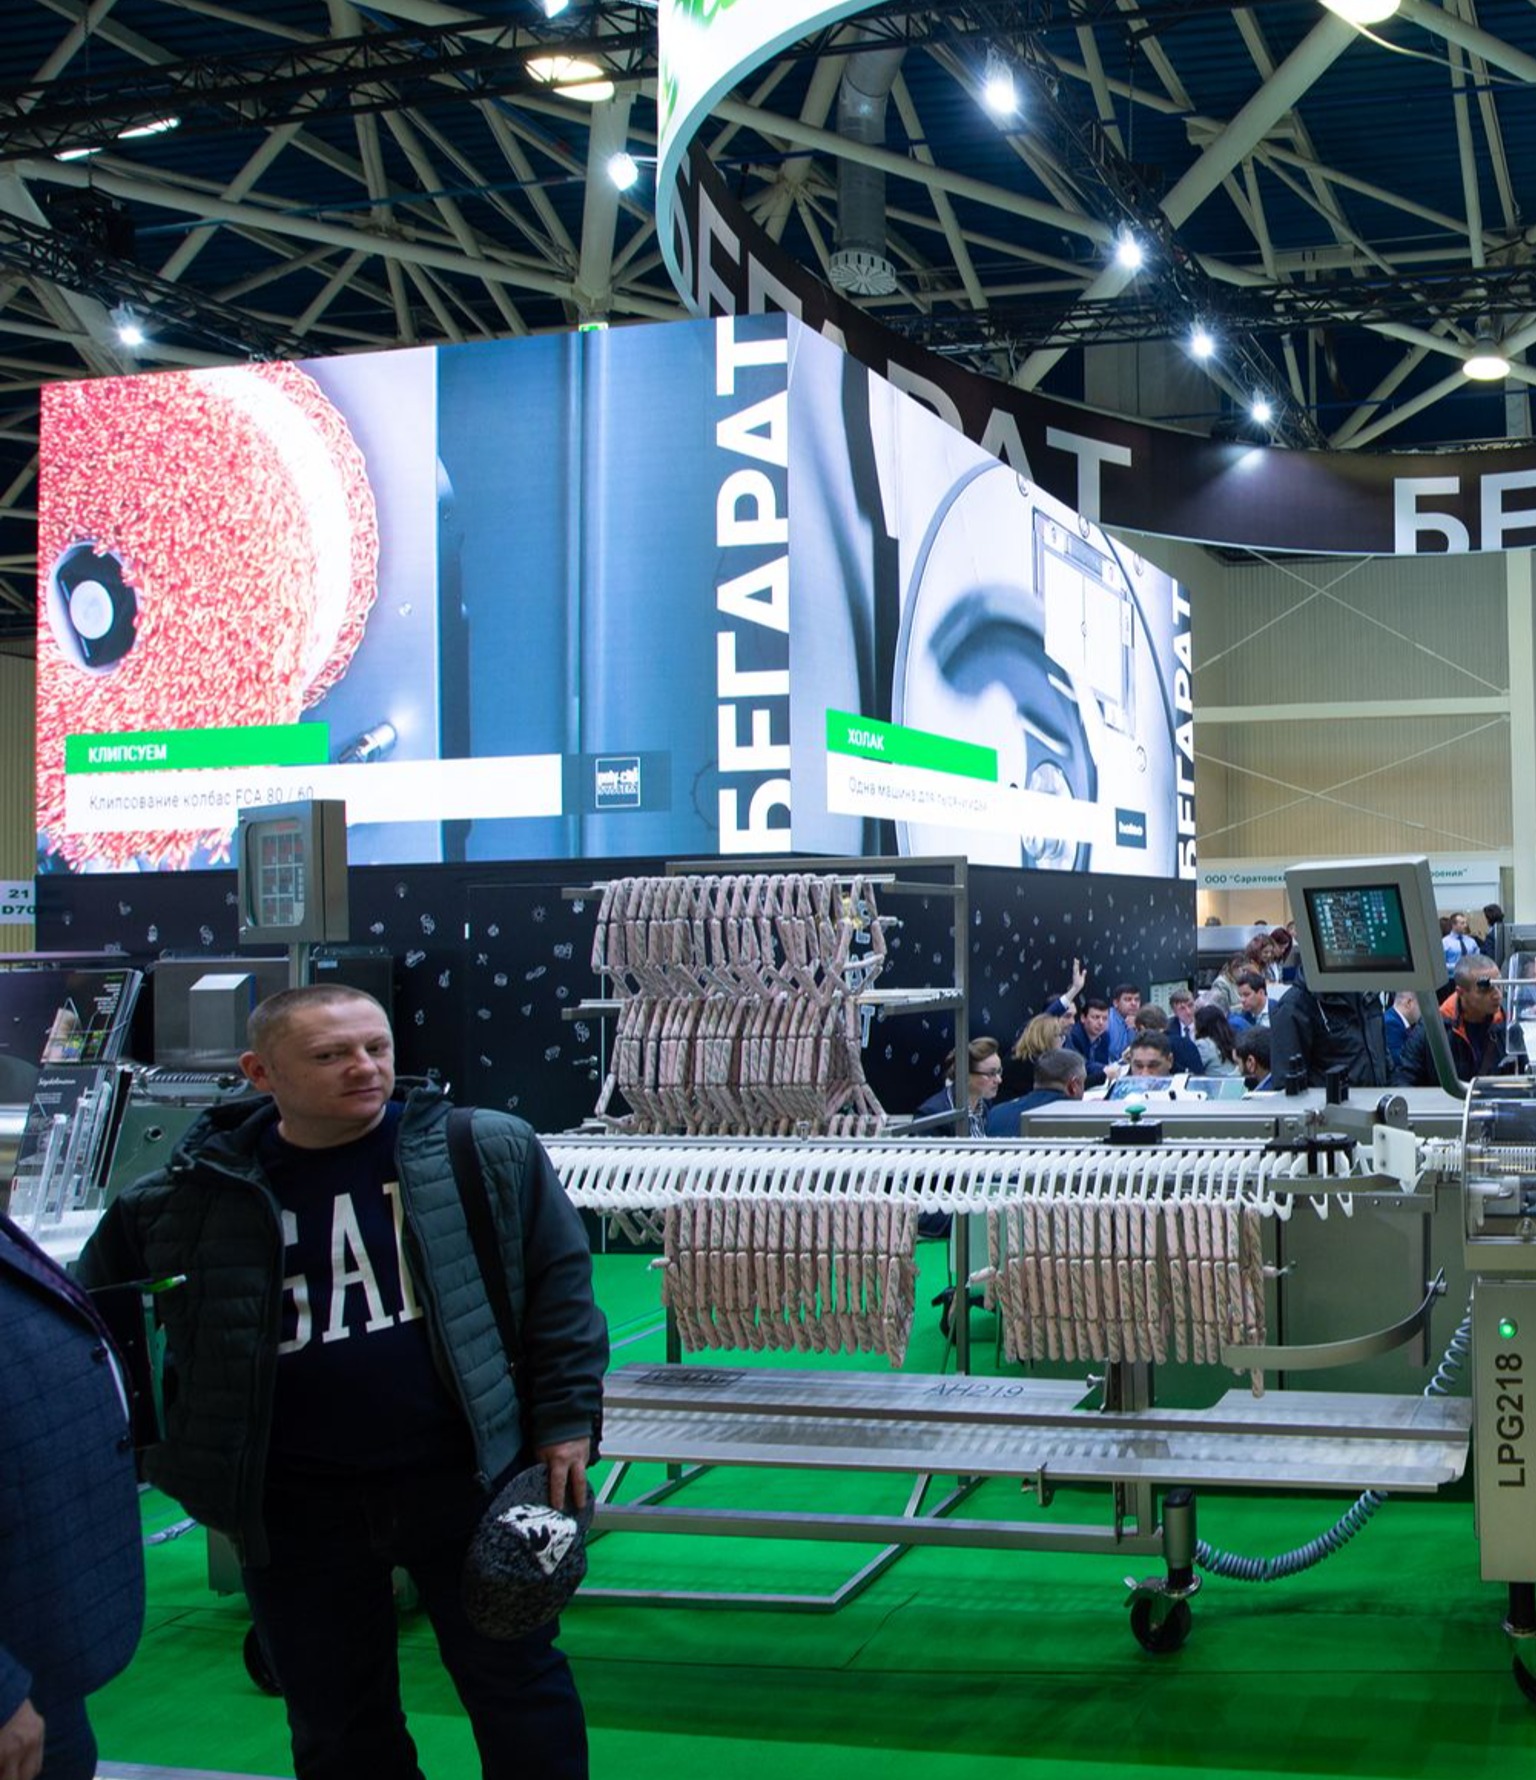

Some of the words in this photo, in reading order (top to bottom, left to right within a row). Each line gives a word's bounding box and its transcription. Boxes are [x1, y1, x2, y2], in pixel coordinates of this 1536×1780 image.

[716, 315, 791, 855] БЕГАРАТ
[848, 728, 885, 751] ХОЛАК
[1172, 577, 1197, 880] БЕГАРАТ
[88, 744, 167, 763] КЛИПСУЕМ
[89, 794, 178, 810] Клипсование
[183, 790, 230, 806] колбас
[236, 788, 262, 804] FCA
[267, 787, 282, 804] 80
[1204, 874, 1227, 884] ООО
[8, 889, 28, 899] 21
[922, 1383, 1025, 1398] AH219
[1495, 1353, 1525, 1488] LPG218
